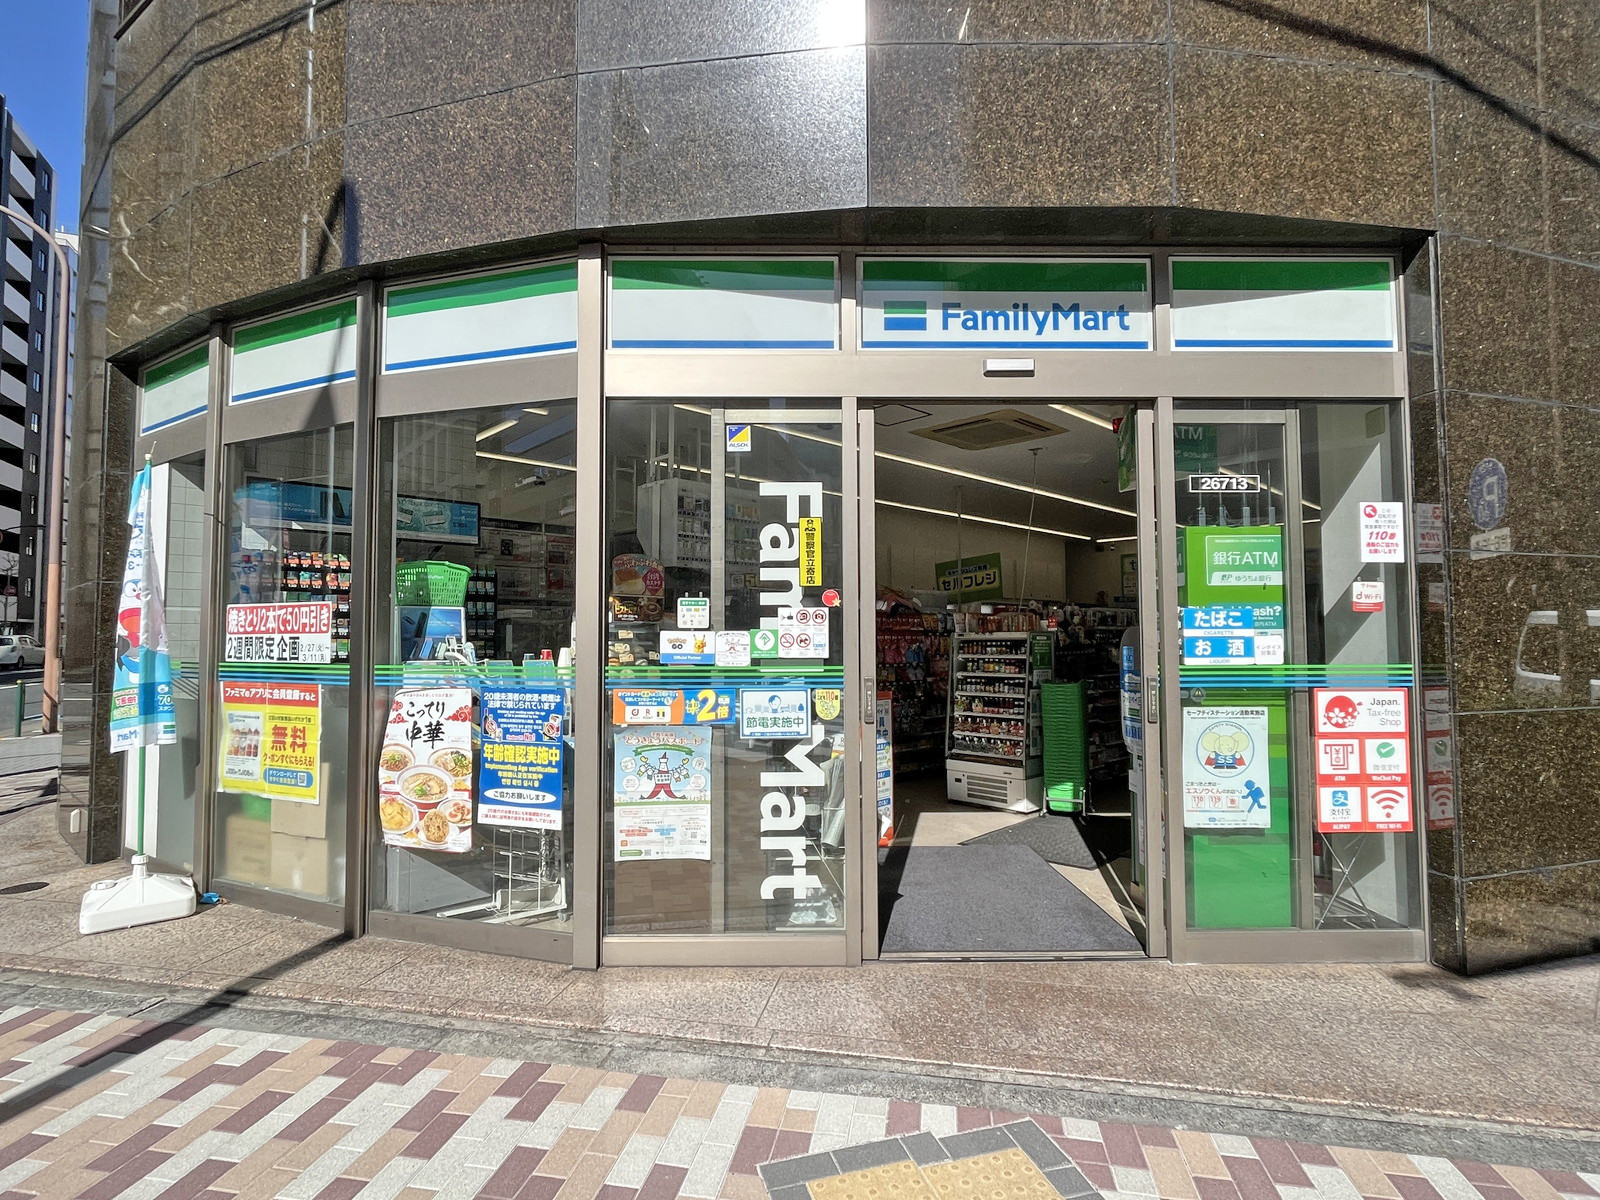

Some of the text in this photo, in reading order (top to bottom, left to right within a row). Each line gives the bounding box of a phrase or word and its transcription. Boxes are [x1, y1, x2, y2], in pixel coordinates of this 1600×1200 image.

[942, 302, 1130, 335] FamilyMart
[1201, 478, 1248, 490] 26713
[1369, 531, 1396, 540] 110番
[804, 532, 816, 585] 警察官立寄店
[1213, 551, 1278, 565] 銀行ATM
[941, 571, 997, 591] セルフレジ
[228, 605, 329, 633] 焼きとり2本で50円引き
[1193, 610, 1244, 628] たばこ
[227, 635, 300, 662] 2週間限定企画
[406, 701, 446, 718] こってり
[1367, 708, 1401, 717] Tax-free
[746, 716, 804, 728] 節電実施中
[1380, 717, 1402, 727] Shop
[405, 720, 446, 749] 中華
[625, 737, 703, 745] とうきょうパスポート
[483, 743, 560, 765] 年齢確認実施中
[1217, 755, 1233, 764] SS
[493, 790, 547, 802] ご協力お願いします
